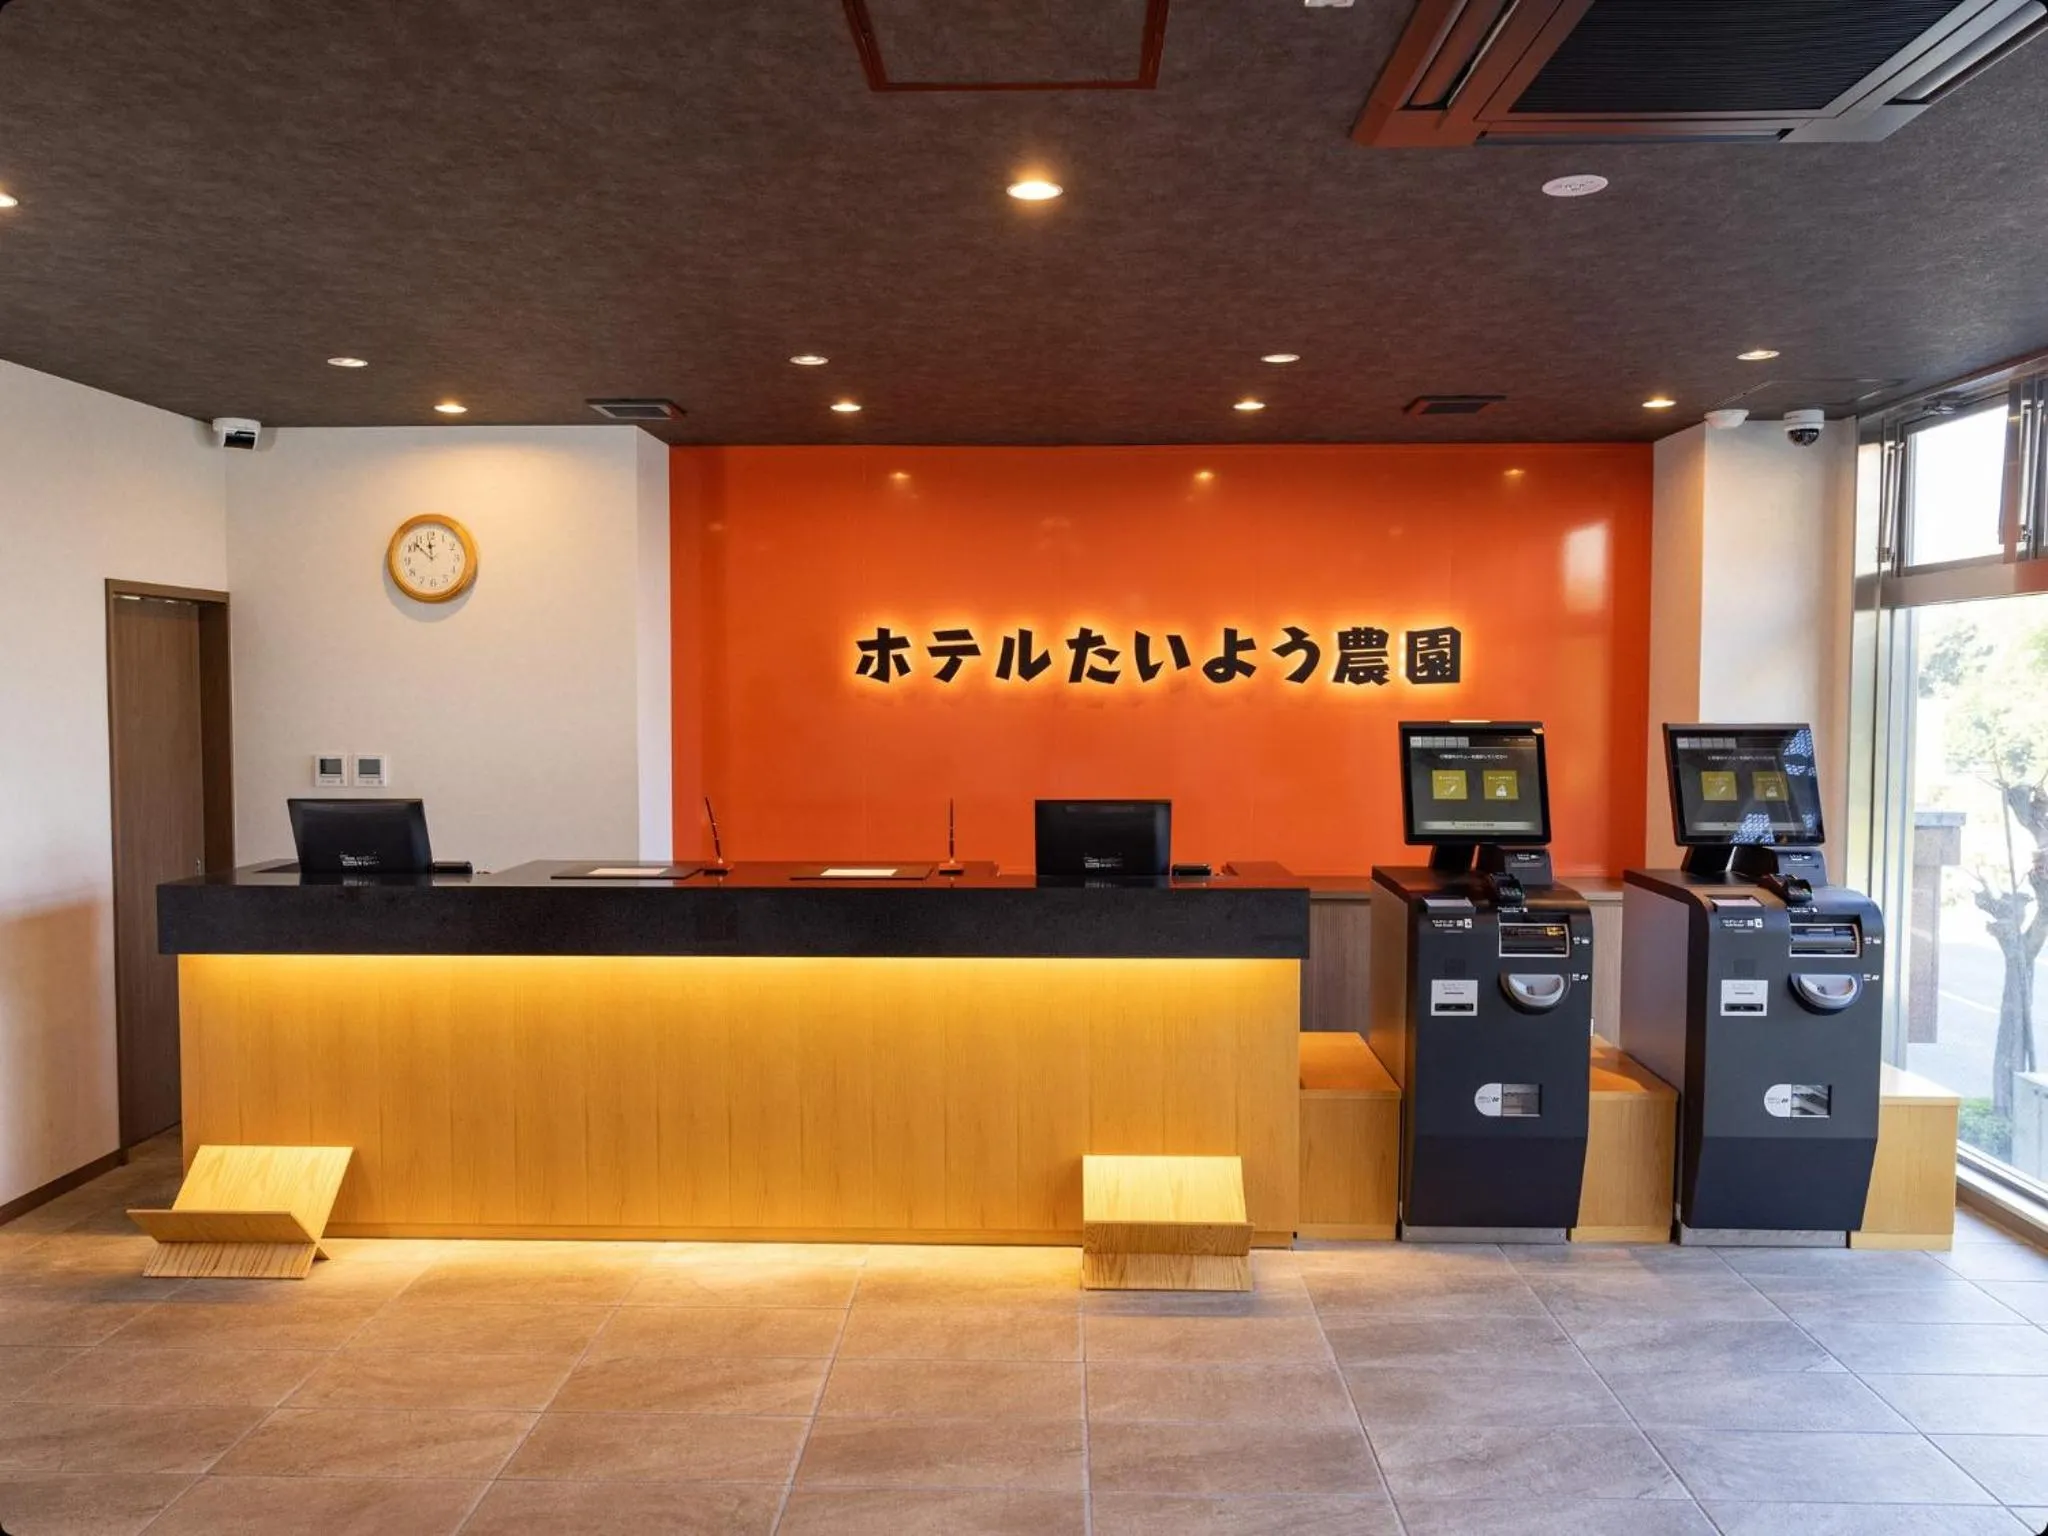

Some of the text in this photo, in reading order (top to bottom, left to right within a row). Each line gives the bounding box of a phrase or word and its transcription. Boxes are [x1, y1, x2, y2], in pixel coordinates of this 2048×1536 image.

[427, 531, 435, 541] 12
[449, 543, 456, 551] 2
[429, 578, 437, 588] 6
[855, 626, 1462, 685] ホテルたいよう農園
